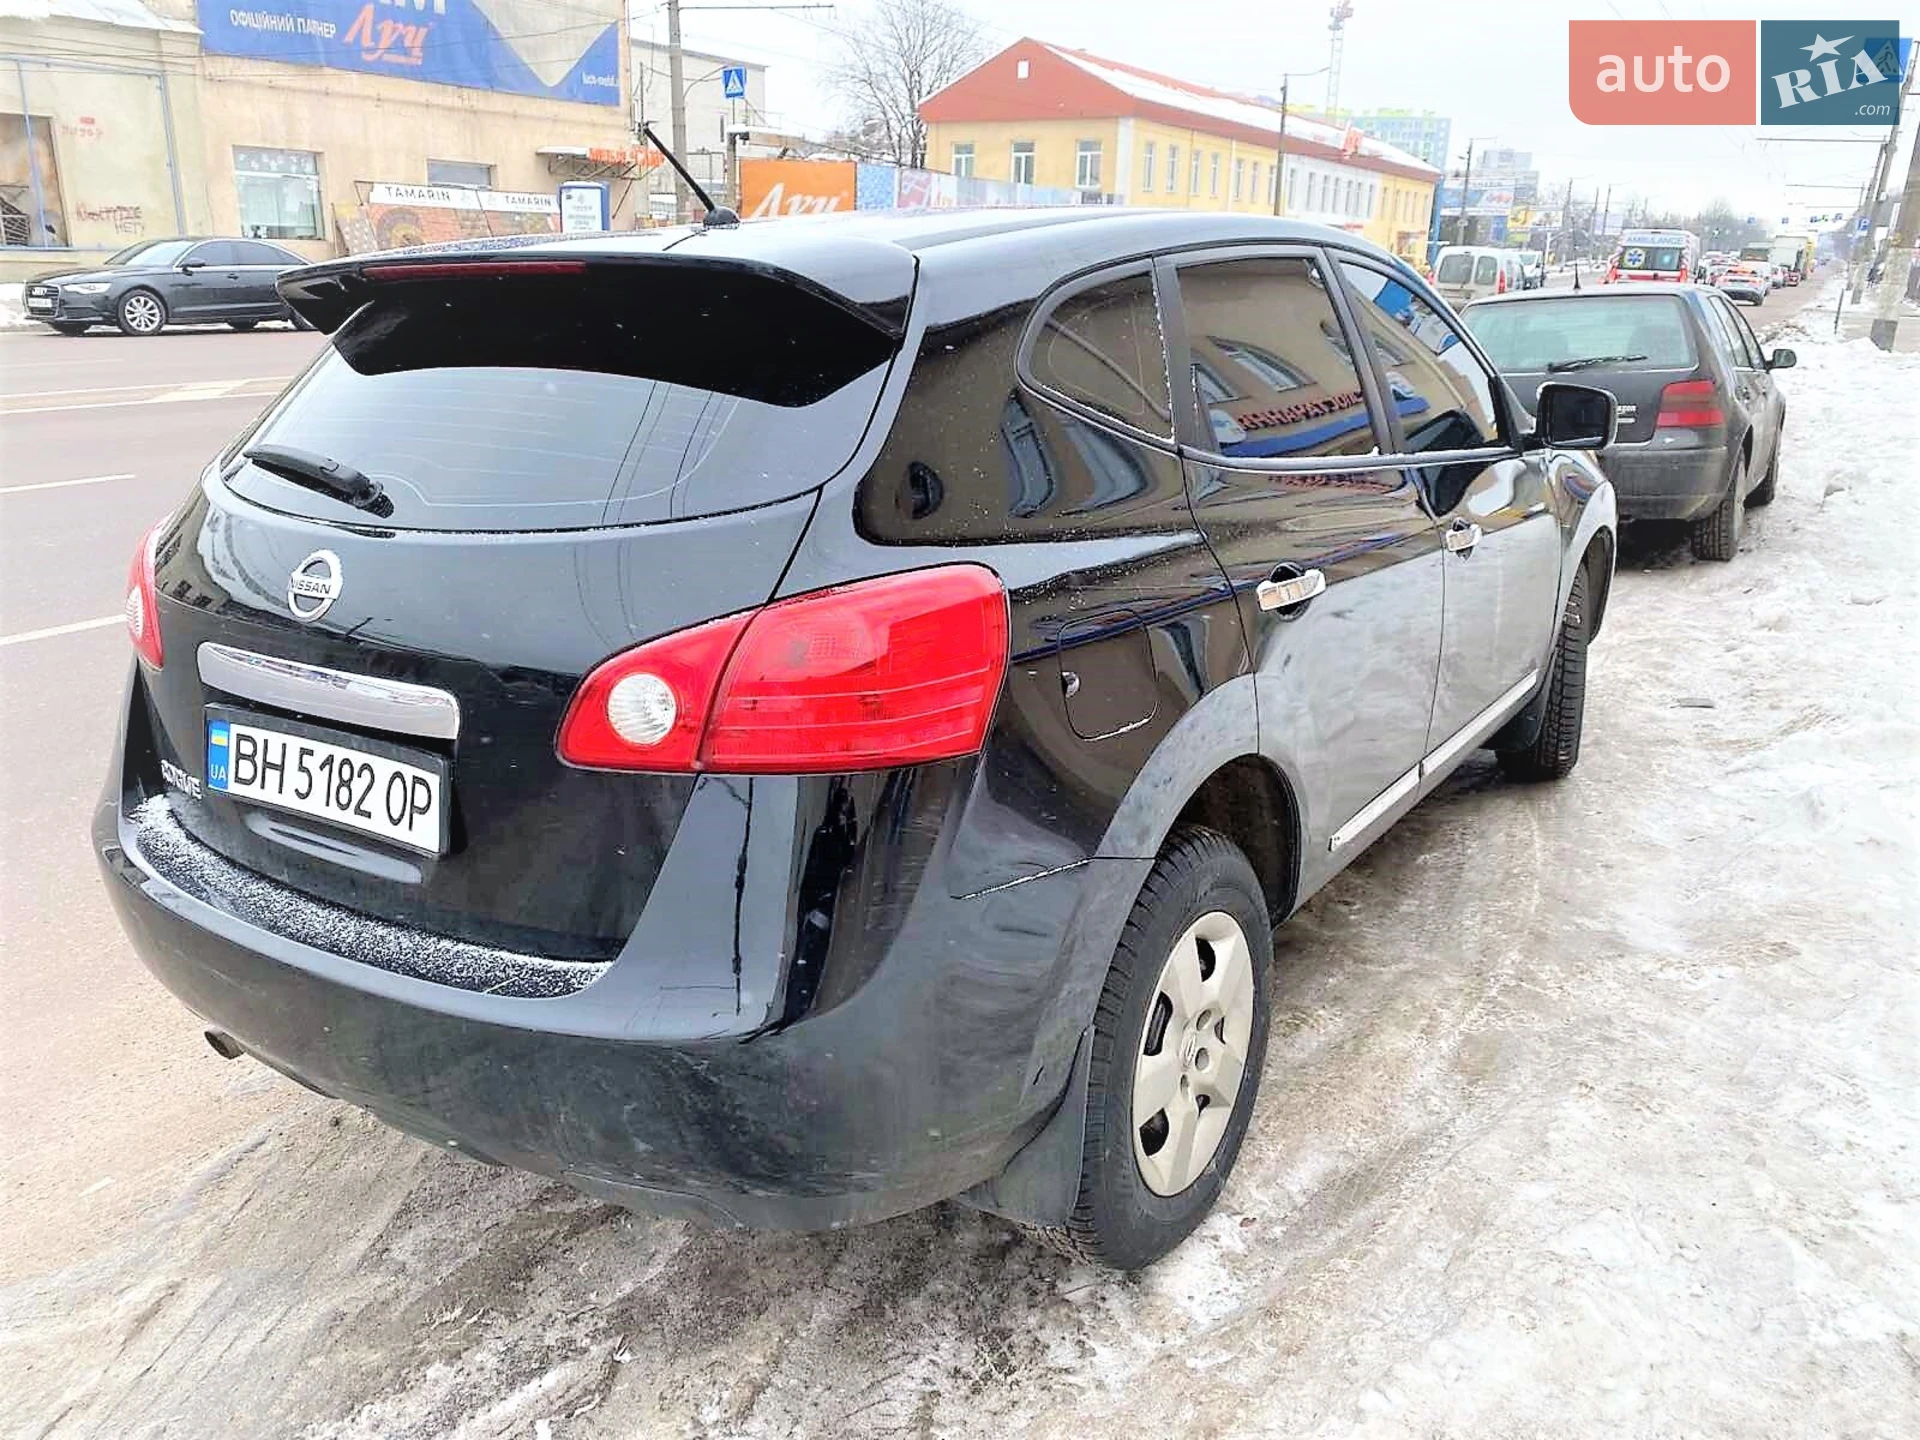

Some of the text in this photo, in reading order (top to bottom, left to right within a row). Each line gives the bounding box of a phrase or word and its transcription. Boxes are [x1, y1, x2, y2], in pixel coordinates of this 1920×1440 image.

[385, 186, 450, 202] TAMARIN
[504, 195, 551, 207] TAMARIN
[1626, 236, 1684, 246] AMBULANCE
[291, 577, 332, 595] NISSAN
[160, 759, 203, 800] ROGUE
[210, 764, 228, 782] UA
[234, 733, 432, 831] BH 5182 OP
